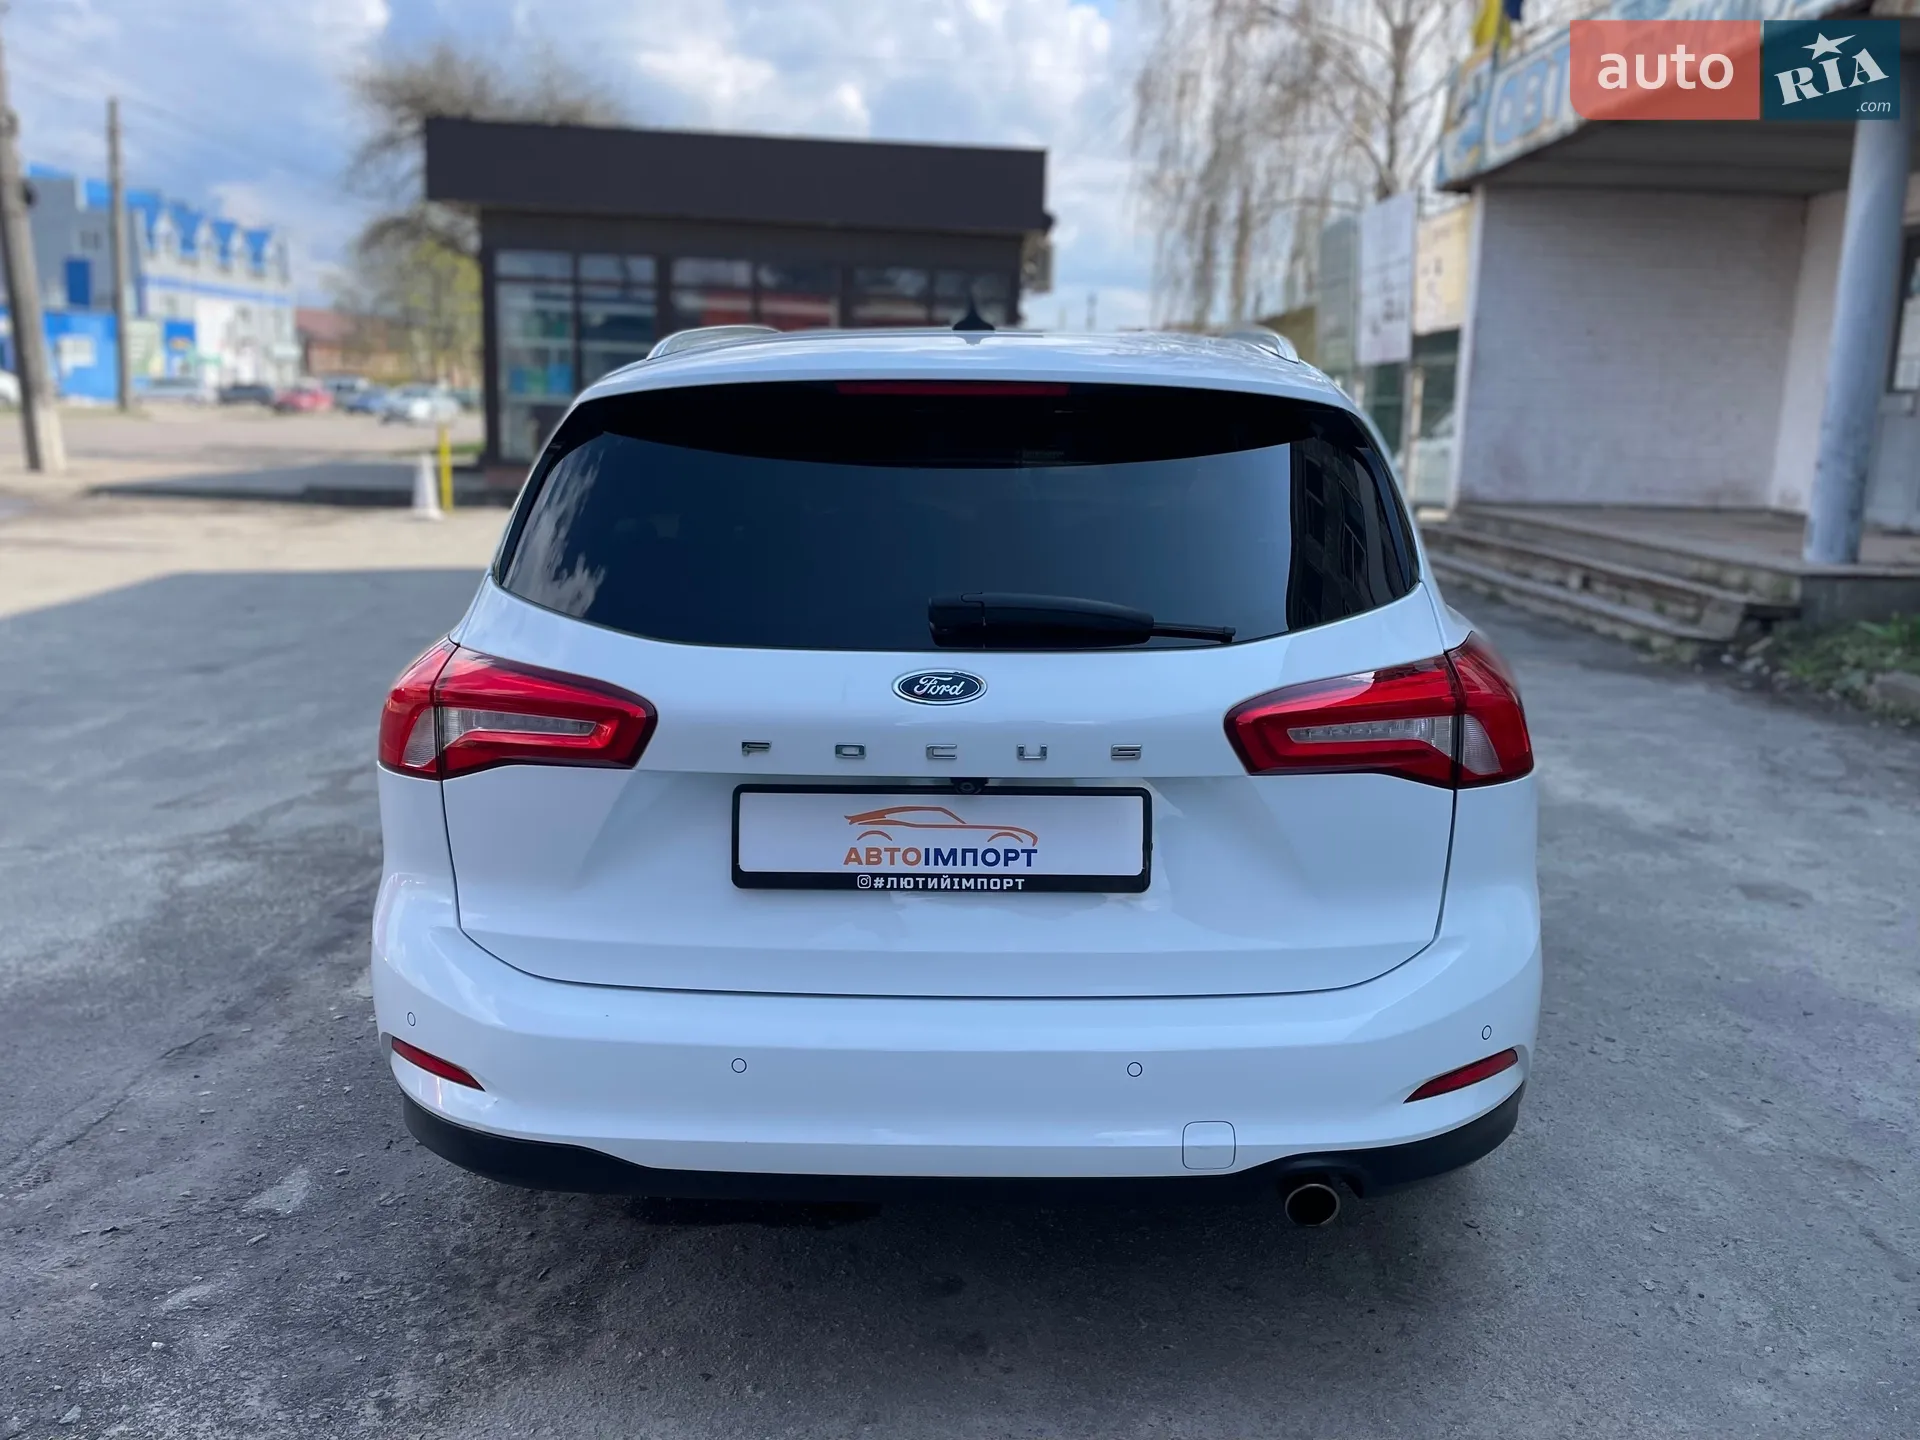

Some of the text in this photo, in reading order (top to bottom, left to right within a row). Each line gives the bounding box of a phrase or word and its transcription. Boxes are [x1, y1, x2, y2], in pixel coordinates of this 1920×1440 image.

[913, 675, 966, 696] Ford
[741, 740, 1143, 761] FOCUS
[843, 846, 1038, 867] АВТОІМПОРТ
